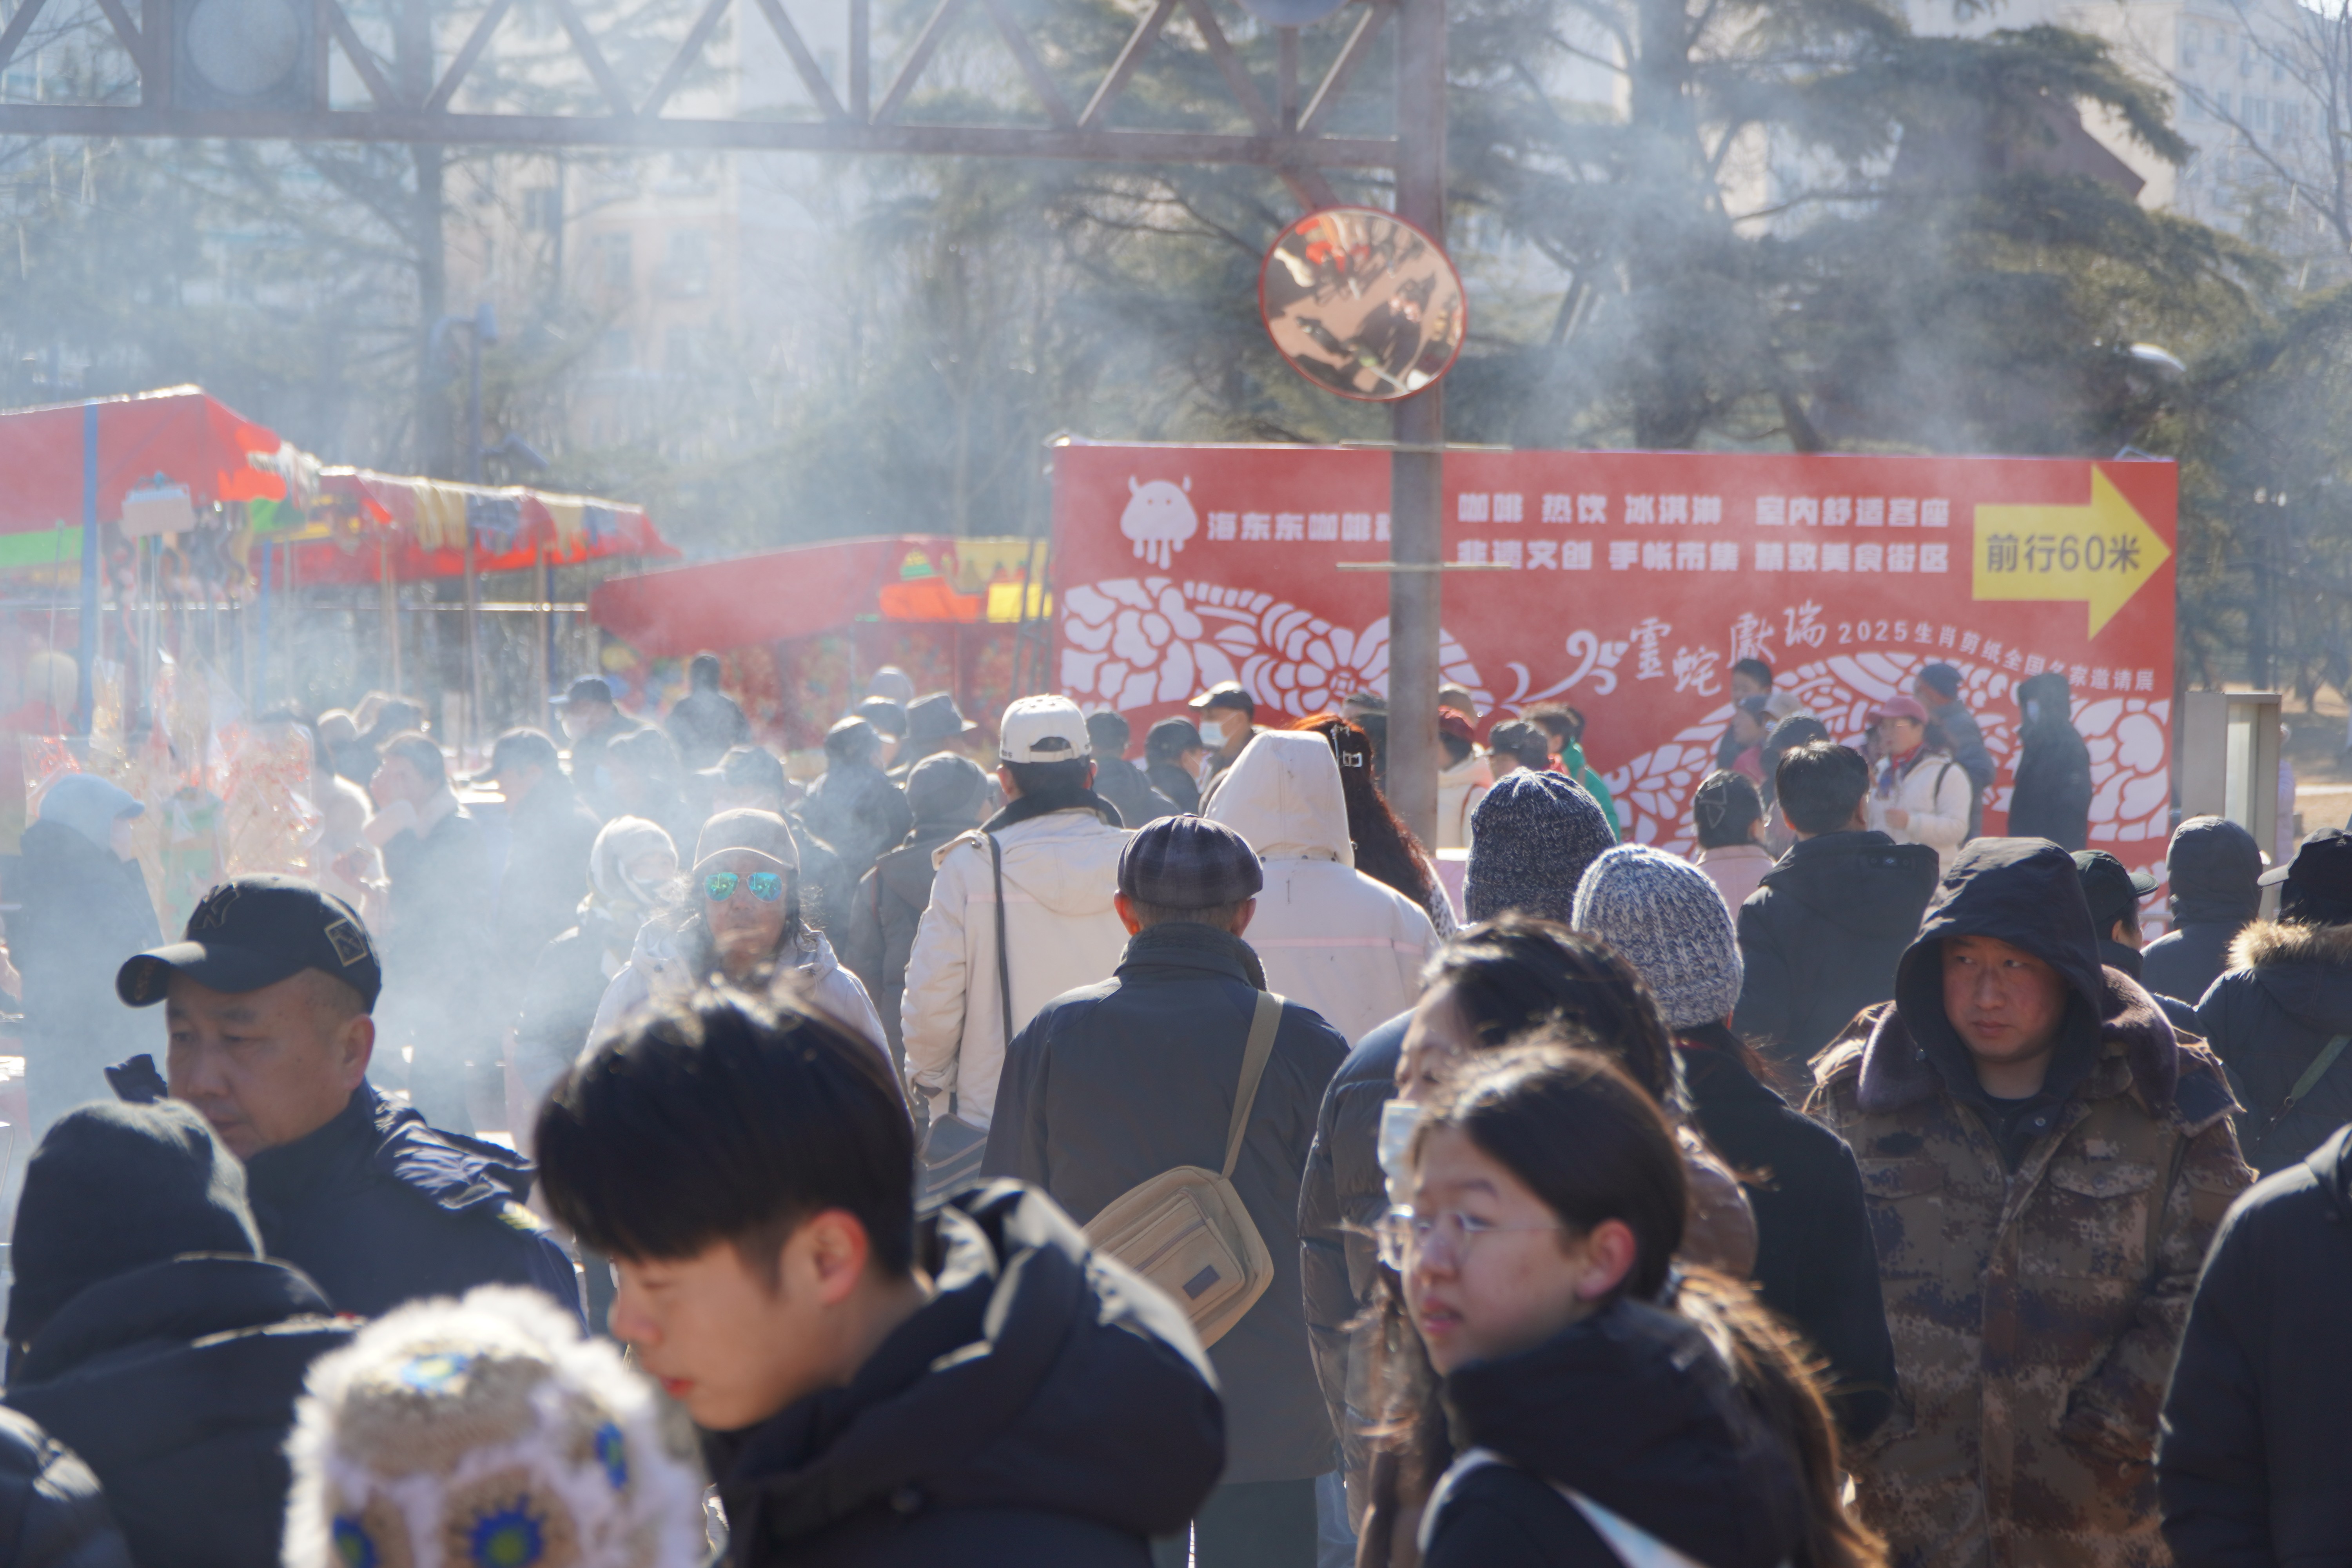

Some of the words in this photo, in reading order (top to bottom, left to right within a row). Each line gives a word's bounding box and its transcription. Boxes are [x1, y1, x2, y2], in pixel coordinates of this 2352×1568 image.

[1457, 493, 1524, 523] 咖啡
[1541, 494, 1607, 524] 热饮
[1624, 494, 1722, 525] 冰淇淋
[1755, 495, 1950, 527] 室内舒适客座
[1457, 539, 1592, 570] 非遗文创
[1754, 541, 1949, 573] 精致美食街区
[1986, 534, 2140, 573] 前行60米
